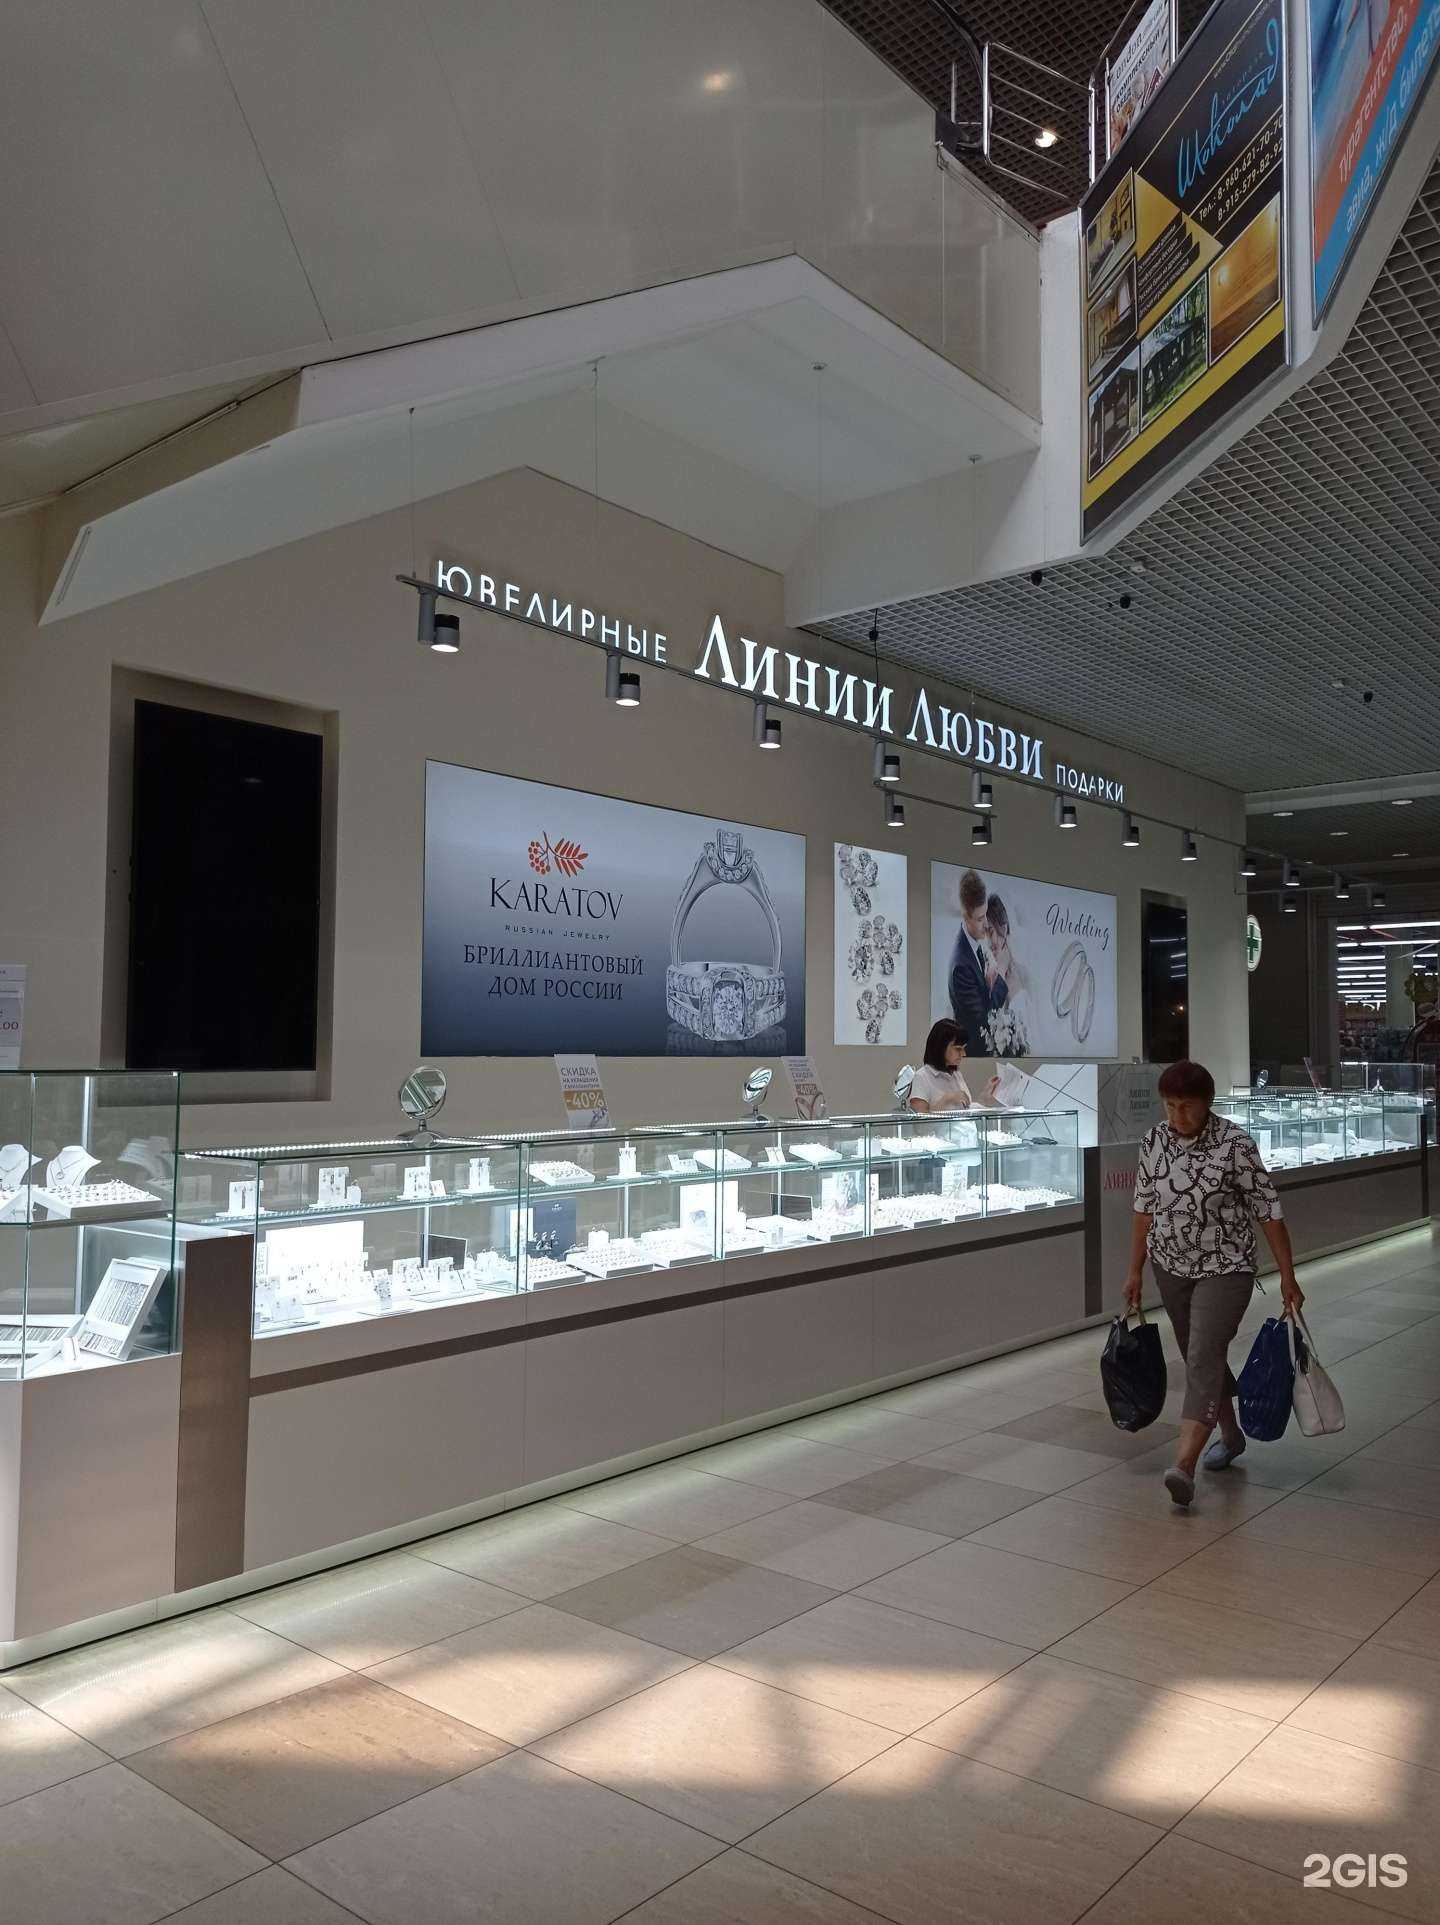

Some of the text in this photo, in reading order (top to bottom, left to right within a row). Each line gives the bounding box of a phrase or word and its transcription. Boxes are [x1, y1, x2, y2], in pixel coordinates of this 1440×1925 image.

[438, 560, 667, 663] ЮВЕЛИРНЫЕ
[1056, 763, 1124, 804] ПОДАРКИ
[490, 877, 623, 920] KARATOV
[505, 924, 610, 942] RUSSIAN JEWELRY
[1046, 903, 1109, 950] Wedding
[463, 944, 644, 975] БРИЛЛИАНТОВЫЙ
[488, 976, 623, 1001] ДОМ РОССИИ
[560, 1066, 597, 1077] СКИДКА
[566, 1092, 605, 1109] -40%
